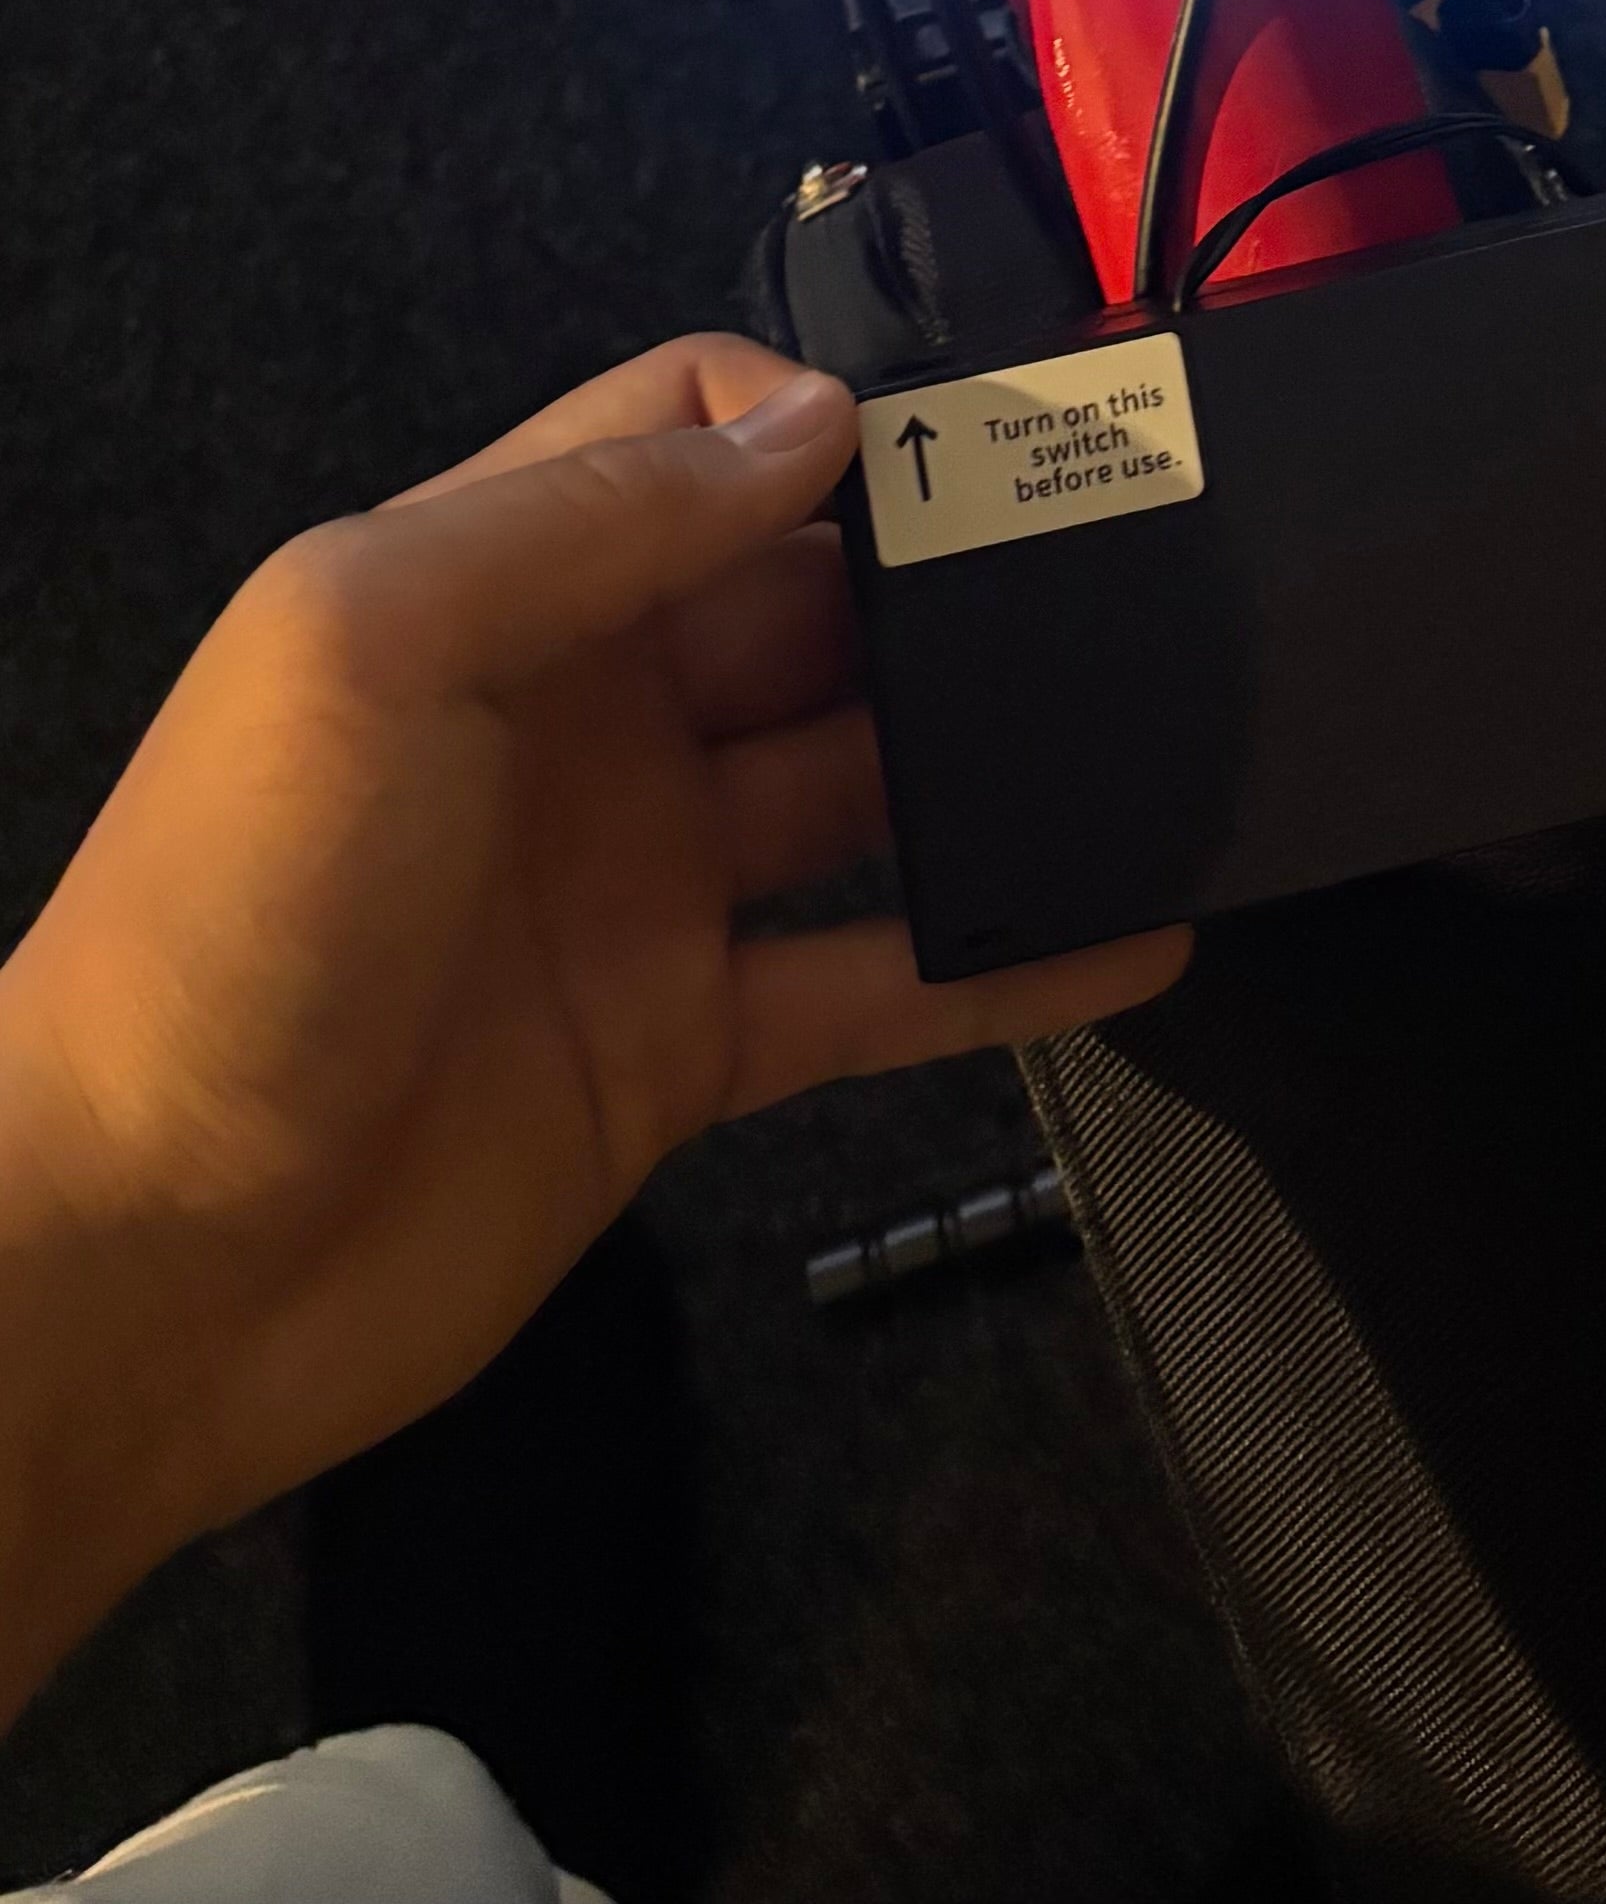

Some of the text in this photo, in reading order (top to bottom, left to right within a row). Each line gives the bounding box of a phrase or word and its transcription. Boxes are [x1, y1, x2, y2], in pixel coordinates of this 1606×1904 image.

[983, 384, 1165, 442] Turn on this
[1031, 423, 1130, 468] switch
[1015, 450, 1184, 503] before use.
